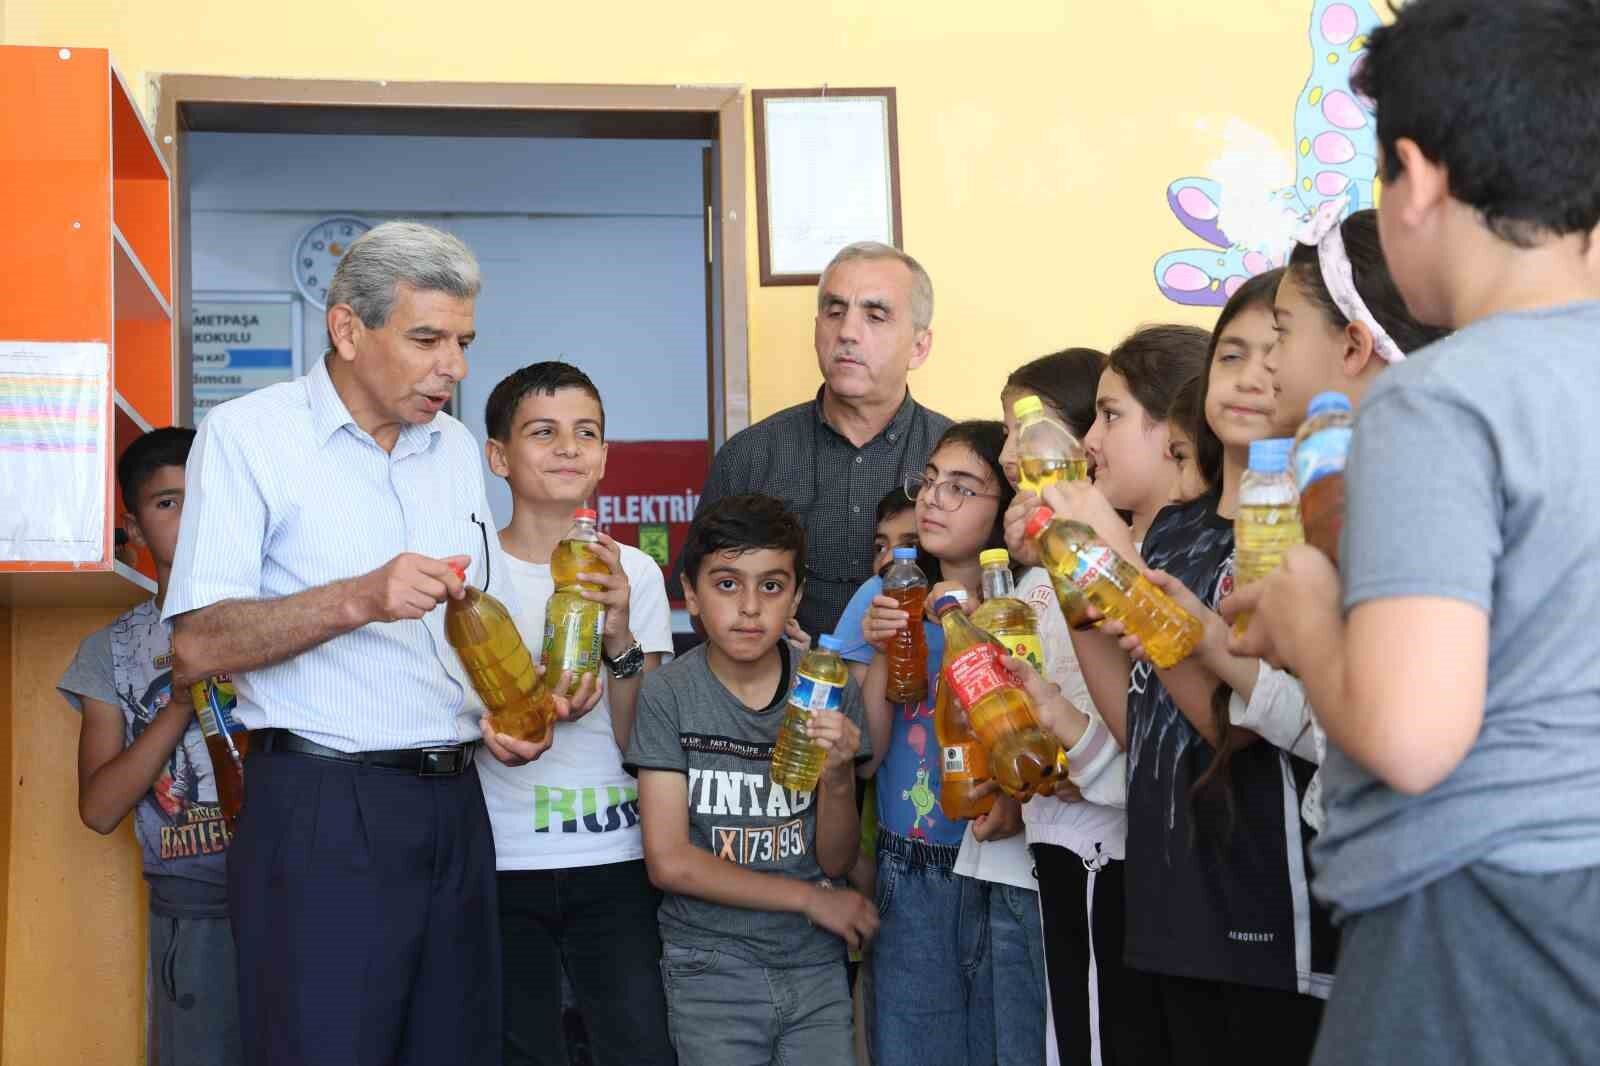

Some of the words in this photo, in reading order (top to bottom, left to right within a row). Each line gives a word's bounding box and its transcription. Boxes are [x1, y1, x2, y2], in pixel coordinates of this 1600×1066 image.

[719, 830, 737, 862] X
[749, 831, 772, 863] 73
[780, 823, 801, 858] 95
